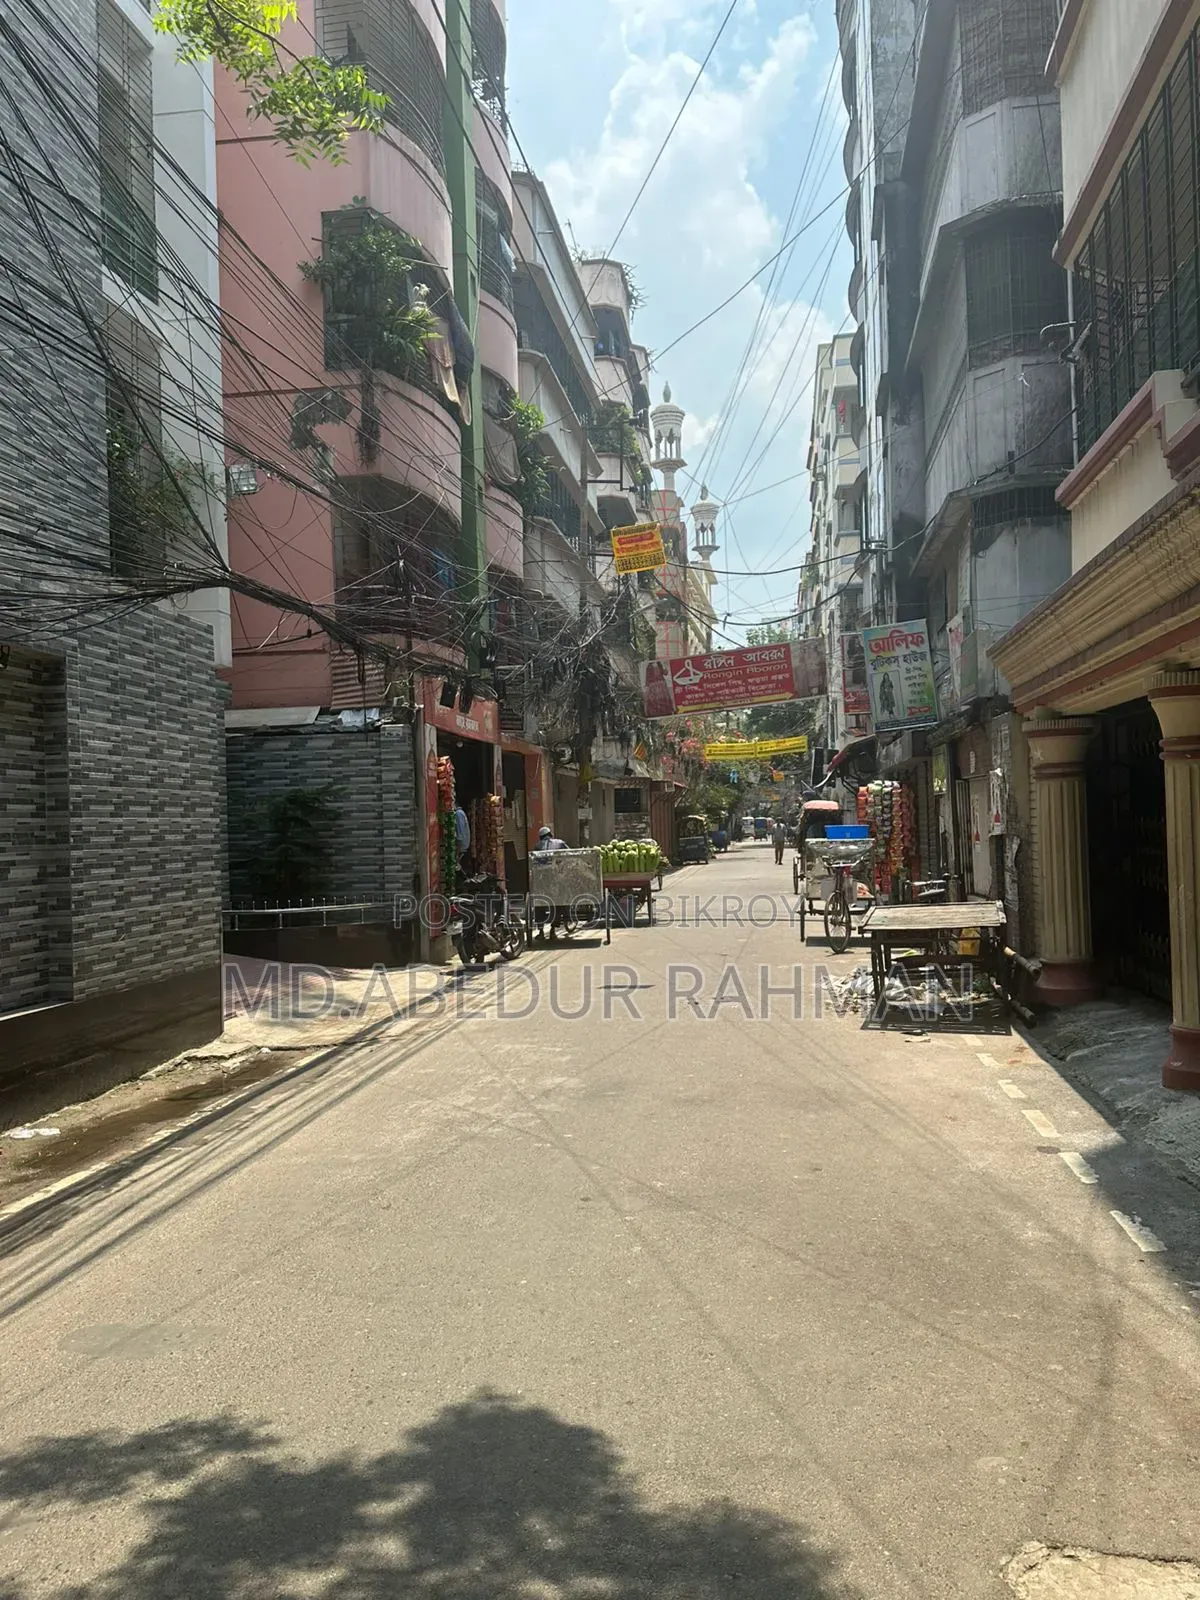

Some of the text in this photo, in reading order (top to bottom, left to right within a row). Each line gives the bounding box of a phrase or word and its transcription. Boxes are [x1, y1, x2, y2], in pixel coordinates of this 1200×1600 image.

[868, 629, 925, 655] আলিফ
[703, 663, 788, 680] Rongin Aboron
